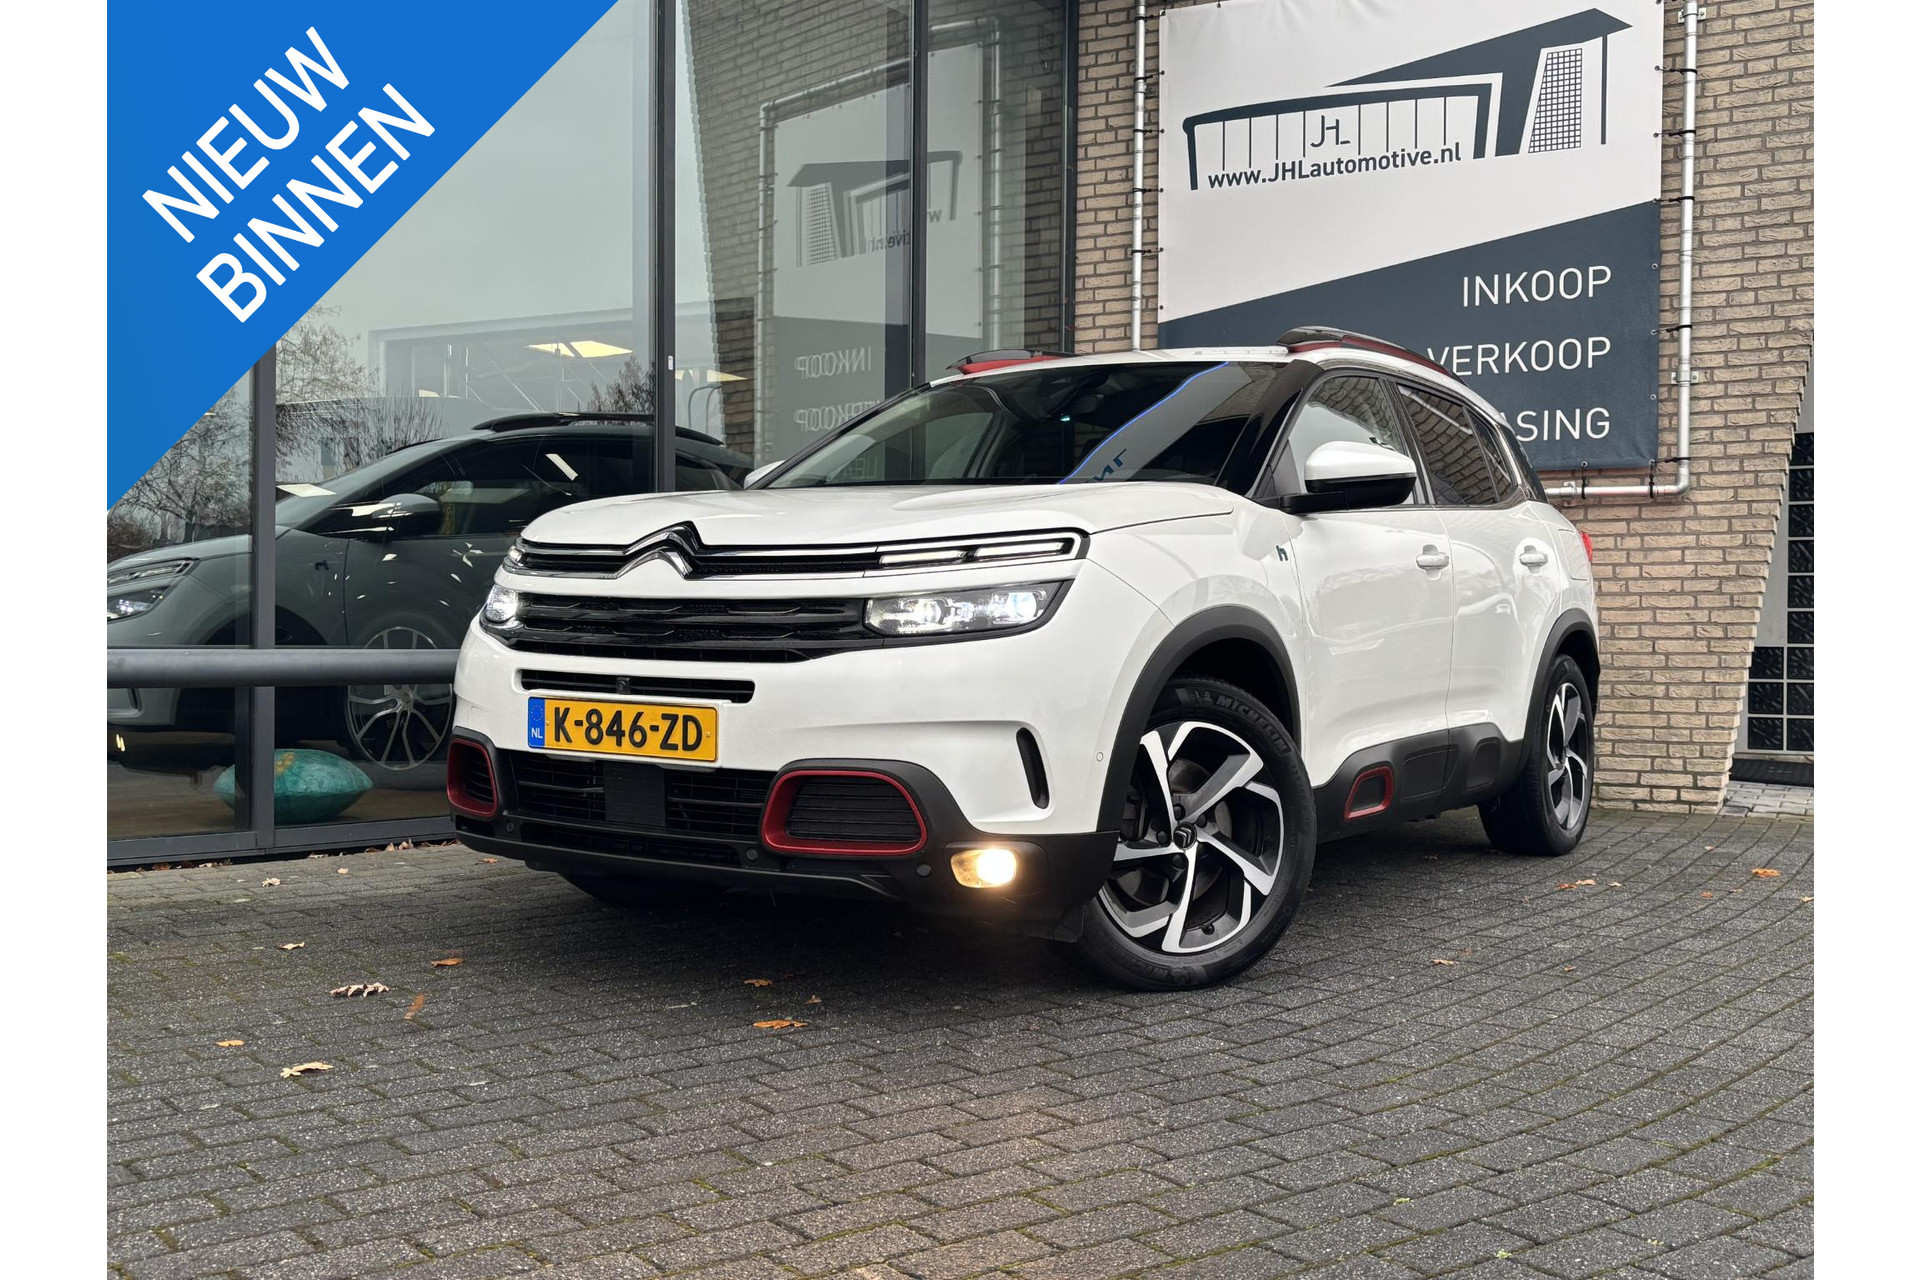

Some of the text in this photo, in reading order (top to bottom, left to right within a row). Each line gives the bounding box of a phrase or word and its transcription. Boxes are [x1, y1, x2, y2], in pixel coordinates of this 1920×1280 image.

[1208, 142, 1461, 189] www.JHLautomotive.nl
[1463, 265, 1612, 308] INKOOP
[1426, 336, 1611, 376] VERKOOP
[1500, 407, 1611, 442] SING
[531, 727, 543, 740] NL
[554, 706, 703, 751] K-846-ZD
[1215, 694, 1292, 756] MICHELIN
